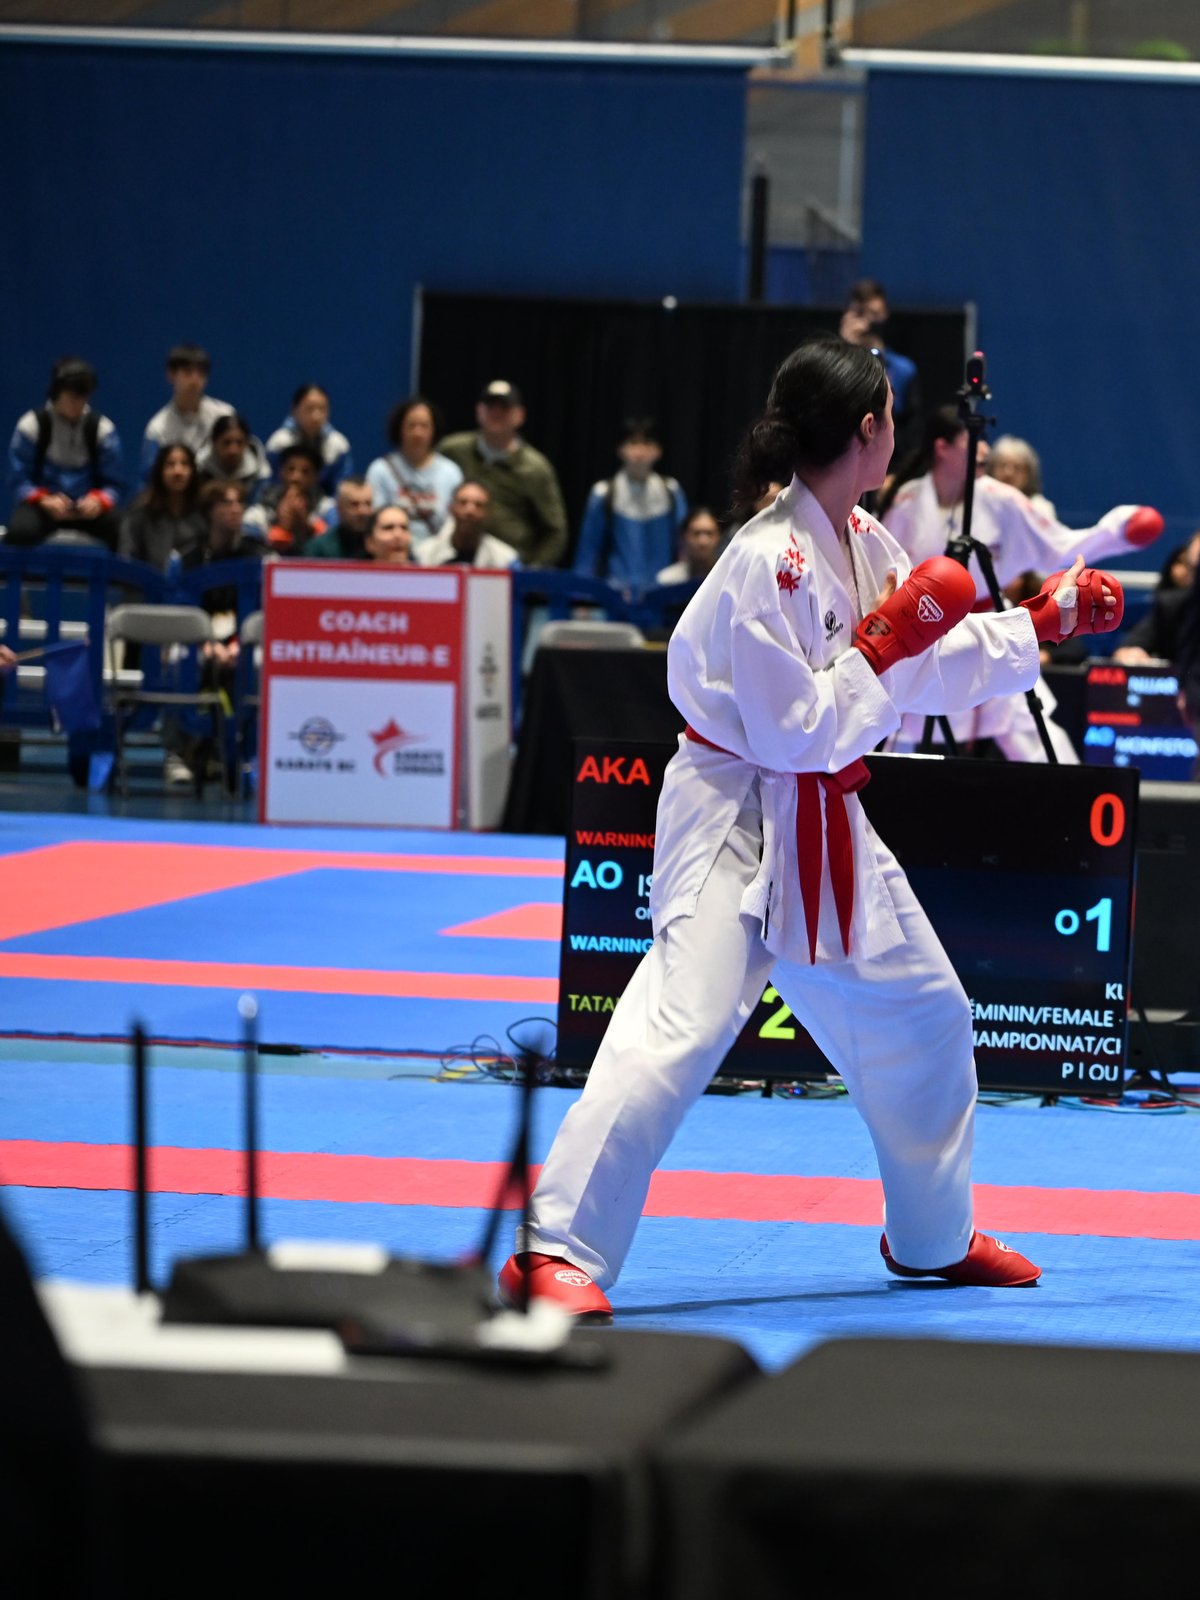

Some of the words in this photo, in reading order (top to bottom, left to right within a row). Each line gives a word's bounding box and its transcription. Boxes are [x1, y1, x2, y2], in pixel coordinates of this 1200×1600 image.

[319, 610, 408, 633] COACH
[576, 755, 651, 785] AKA
[1089, 793, 1125, 846] 0
[571, 859, 623, 889] AO
[568, 994, 621, 1012] TATA
[758, 986, 796, 1040] 2
